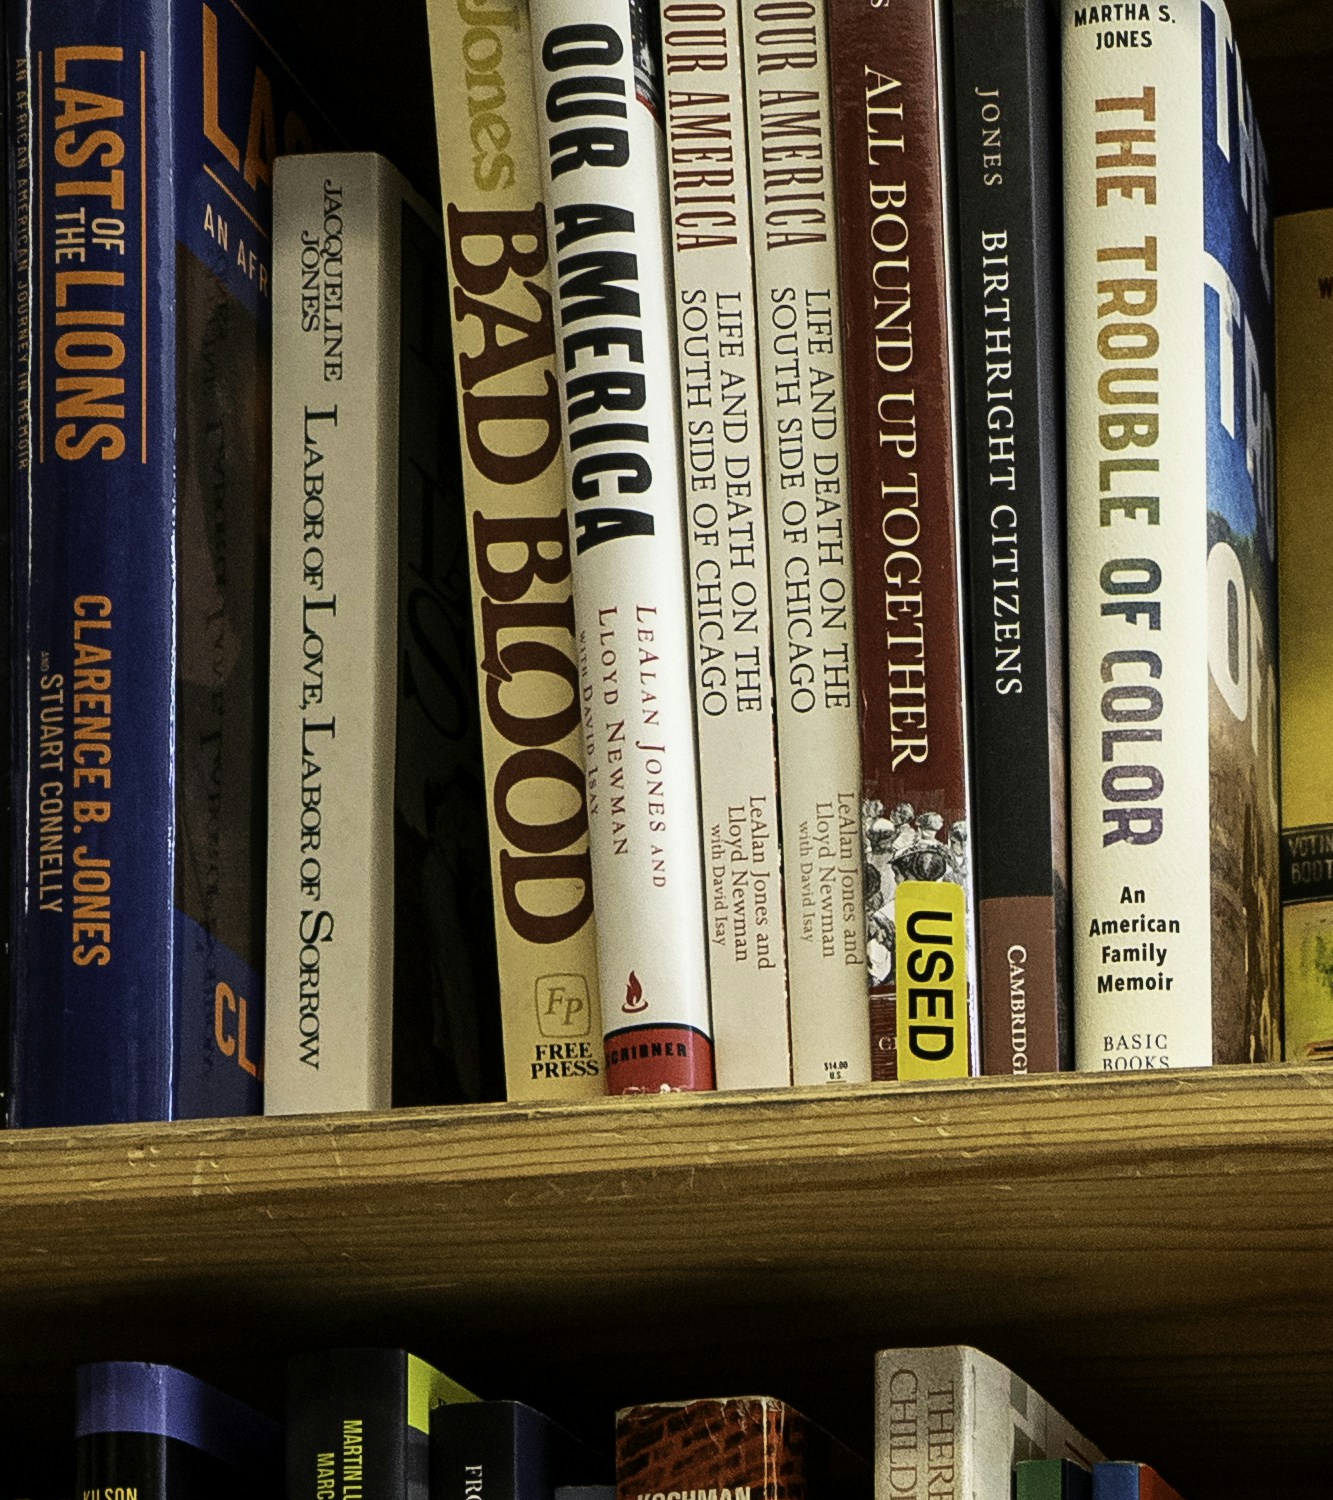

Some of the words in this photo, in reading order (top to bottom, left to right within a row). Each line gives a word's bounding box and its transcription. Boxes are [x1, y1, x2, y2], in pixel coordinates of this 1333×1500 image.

[54, 46, 125, 210] LAST
[1095, 87, 1156, 207] THE
[55, 207, 85, 264] THE
[92, 218, 125, 255] OF
[301, 232, 322, 334] JONES
[322, 179, 344, 382] JACQUELINE
[55, 271, 125, 460] LIONS
[451, 203, 563, 485] BAD
[983, 231, 1021, 490] BIRTHRIGHT
[1096, 236, 1159, 527] TROUBLE
[992, 505, 1024, 697] CITIZENS
[1100, 559, 1162, 630] OF
[473, 508, 594, 943] BLOOD
[1100, 650, 1164, 847] COLOR
[907, 911, 953, 1060] USED
